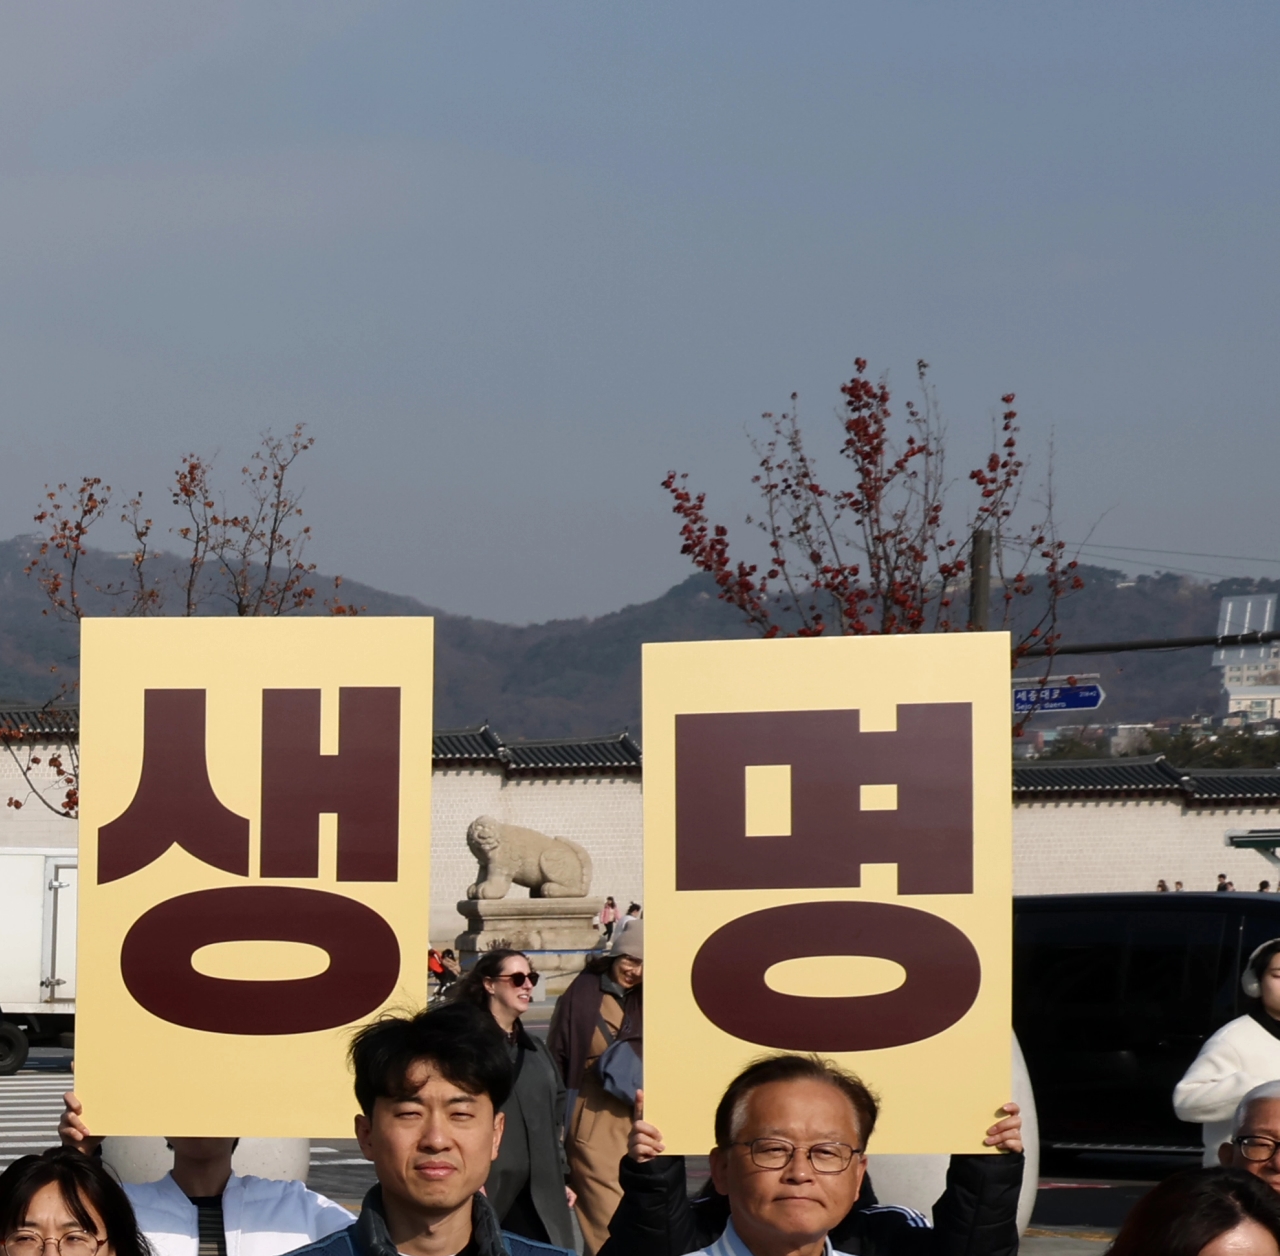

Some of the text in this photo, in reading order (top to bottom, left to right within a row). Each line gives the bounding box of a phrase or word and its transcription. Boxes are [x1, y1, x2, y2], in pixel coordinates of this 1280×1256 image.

[97, 687, 401, 1035] 생
[1016, 689, 1060, 702] 세종대로
[675, 702, 981, 1052] 명
